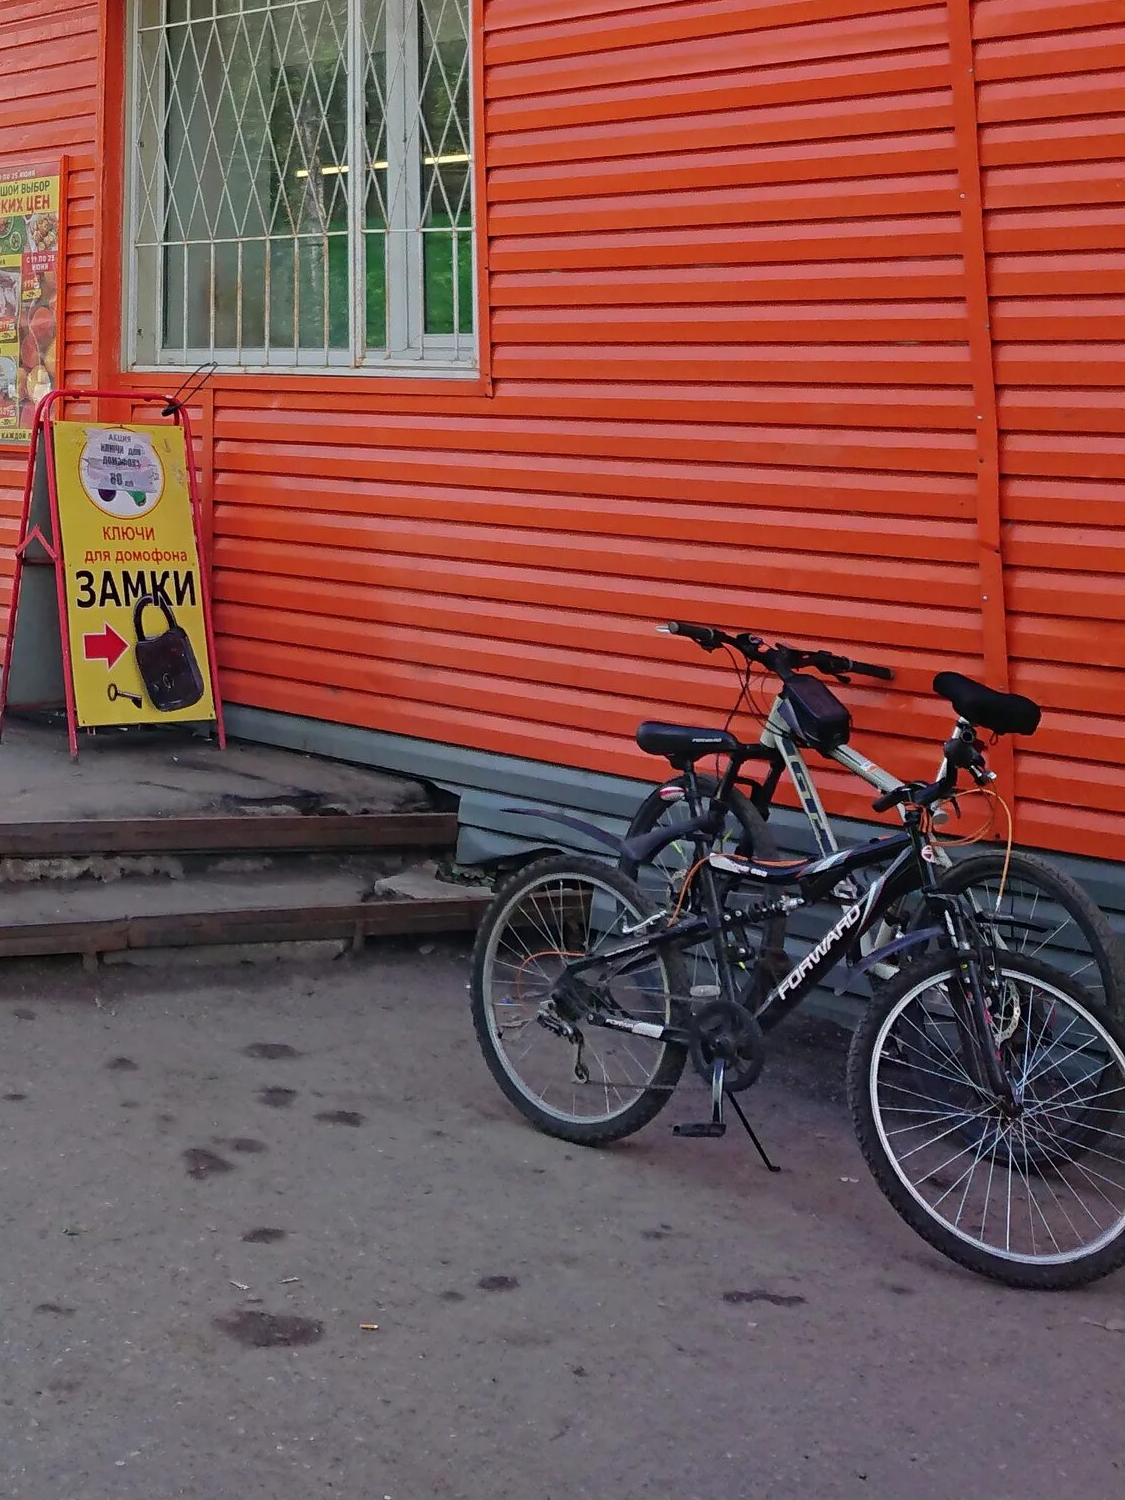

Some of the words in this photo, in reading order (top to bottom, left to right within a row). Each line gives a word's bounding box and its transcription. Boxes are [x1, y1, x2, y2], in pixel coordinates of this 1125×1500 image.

[21, 180, 51, 195] ВЫБОР
[26, 194, 51, 213] ЦЕН
[108, 433, 132, 443] АКЦИЯ
[100, 443, 125, 454] КЛЮЧИ
[102, 525, 156, 541] КЛЮЧИ
[84, 550, 111, 564] для
[115, 547, 188, 565] домофона
[75, 569, 196, 609] ЗАМКИ
[778, 904, 861, 1000] FORWARD
